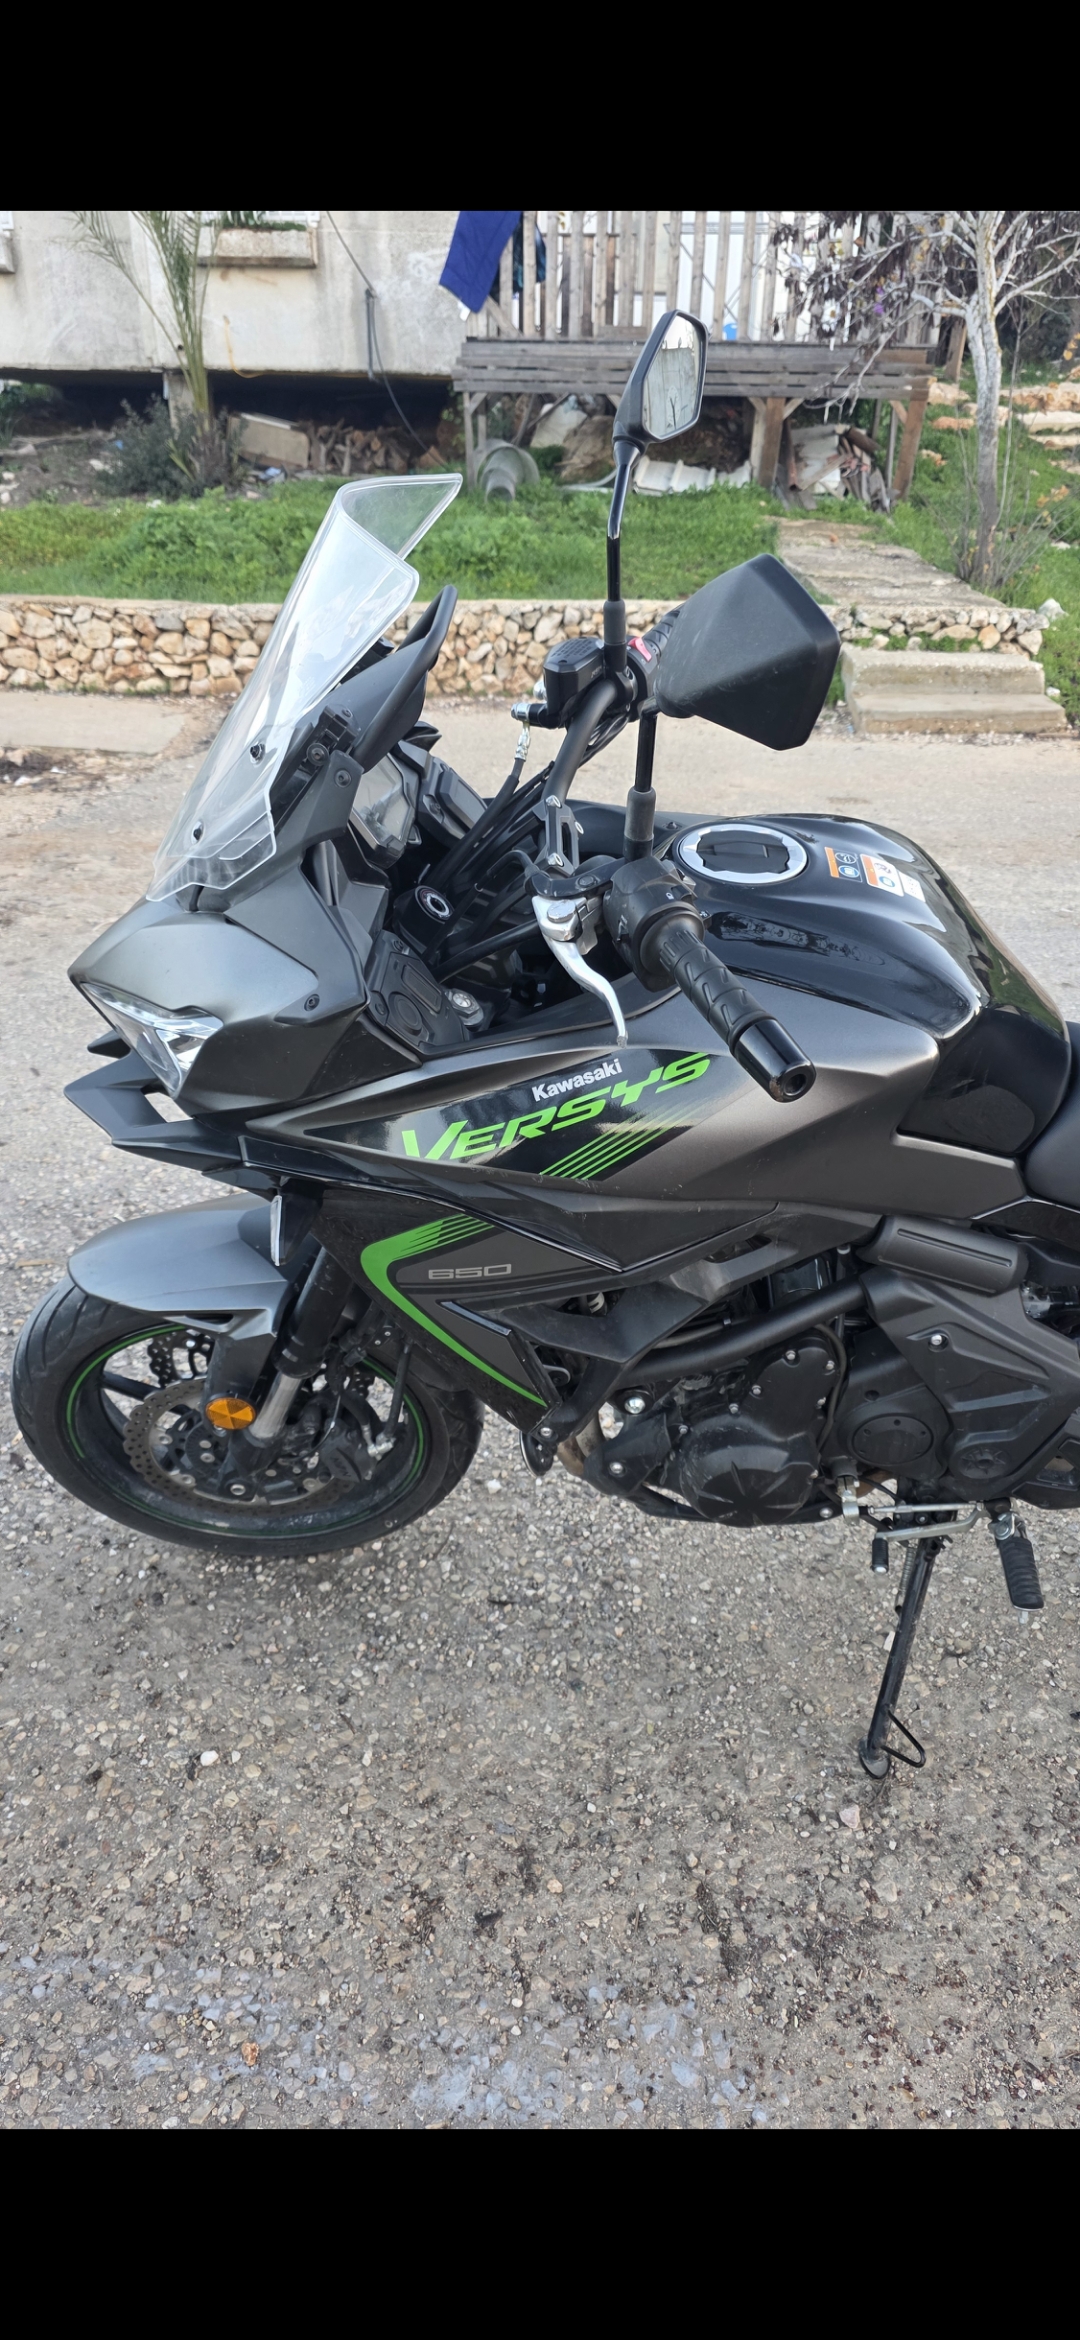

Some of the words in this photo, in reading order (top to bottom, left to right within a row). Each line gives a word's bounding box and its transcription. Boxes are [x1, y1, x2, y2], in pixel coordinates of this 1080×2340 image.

[532, 1058, 622, 1101] Kawasaki
[401, 1052, 710, 1160] VERSYS
[428, 1263, 512, 1280] 650
